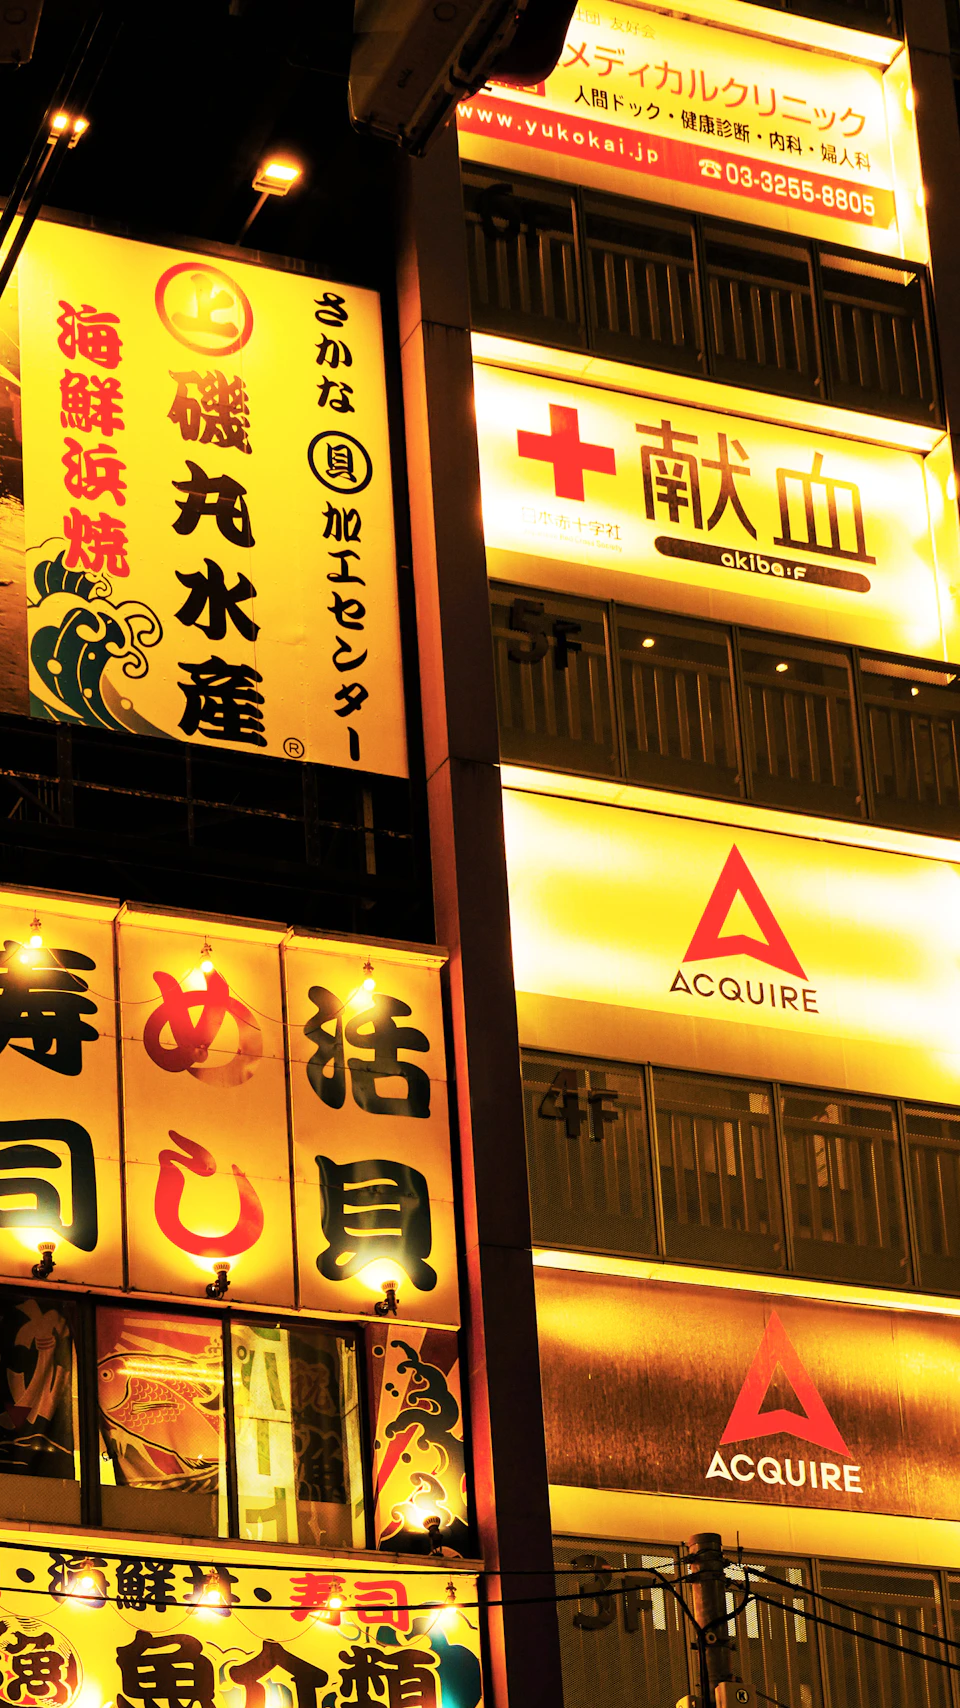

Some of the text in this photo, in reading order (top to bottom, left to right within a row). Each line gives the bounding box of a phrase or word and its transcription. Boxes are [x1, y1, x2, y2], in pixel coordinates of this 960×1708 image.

[457, 103, 659, 164] www.yukokai.jp
[556, 41, 867, 138] メディカルクリニック
[574, 85, 872, 173] 人間ドック・健康診断・内科・婦人科
[725, 163, 877, 218] 03-3255-8805
[56, 299, 131, 578] 海鮮浜焼
[522, 506, 622, 541] 日本赤十字社
[635, 419, 877, 565] 献血
[166, 369, 268, 748] 磯丸水産
[669, 969, 820, 1014] ACQUIRE
[142, 969, 265, 1259] めし
[304, 985, 438, 1292] 活貝
[538, 1067, 619, 1143] 4F
[705, 1450, 864, 1495] ACQUIRE
